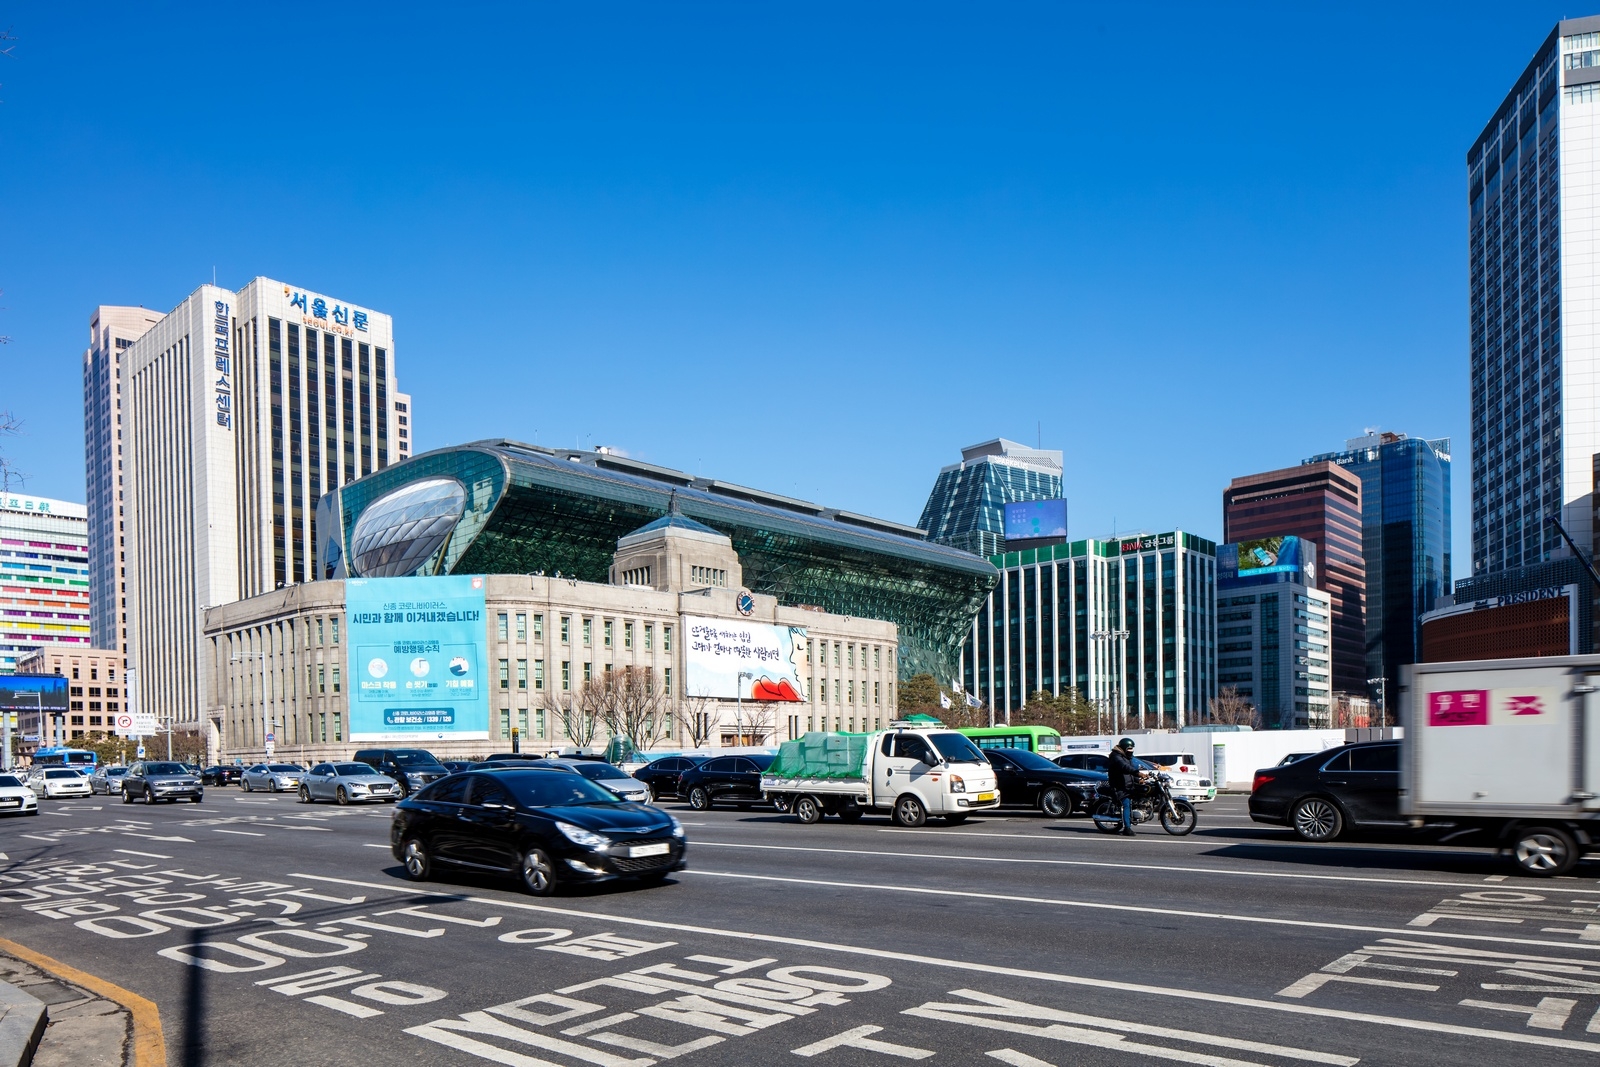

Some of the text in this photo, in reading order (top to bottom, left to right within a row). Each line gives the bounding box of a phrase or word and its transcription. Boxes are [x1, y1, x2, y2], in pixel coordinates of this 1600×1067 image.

[291, 292, 369, 332] 서울신문
[302, 315, 354, 338] seoul.co.kr
[214, 300, 231, 431] 한국프레스센터
[995, 457, 1029, 469] SPARKPLUS
[1337, 457, 1354, 465] Bank
[1122, 536, 1174, 552] BNK 금융그룹
[383, 602, 397, 611] 신종
[1497, 586, 1564, 607] PRESIDENT
[353, 610, 480, 624] 시민과 함께 이겨내겠습니다!
[393, 645, 440, 654] 예방행동수칙
[21, 877, 294, 919] 토요일
[74, 887, 366, 939] 14:00
[157, 905, 503, 974] 11:00
